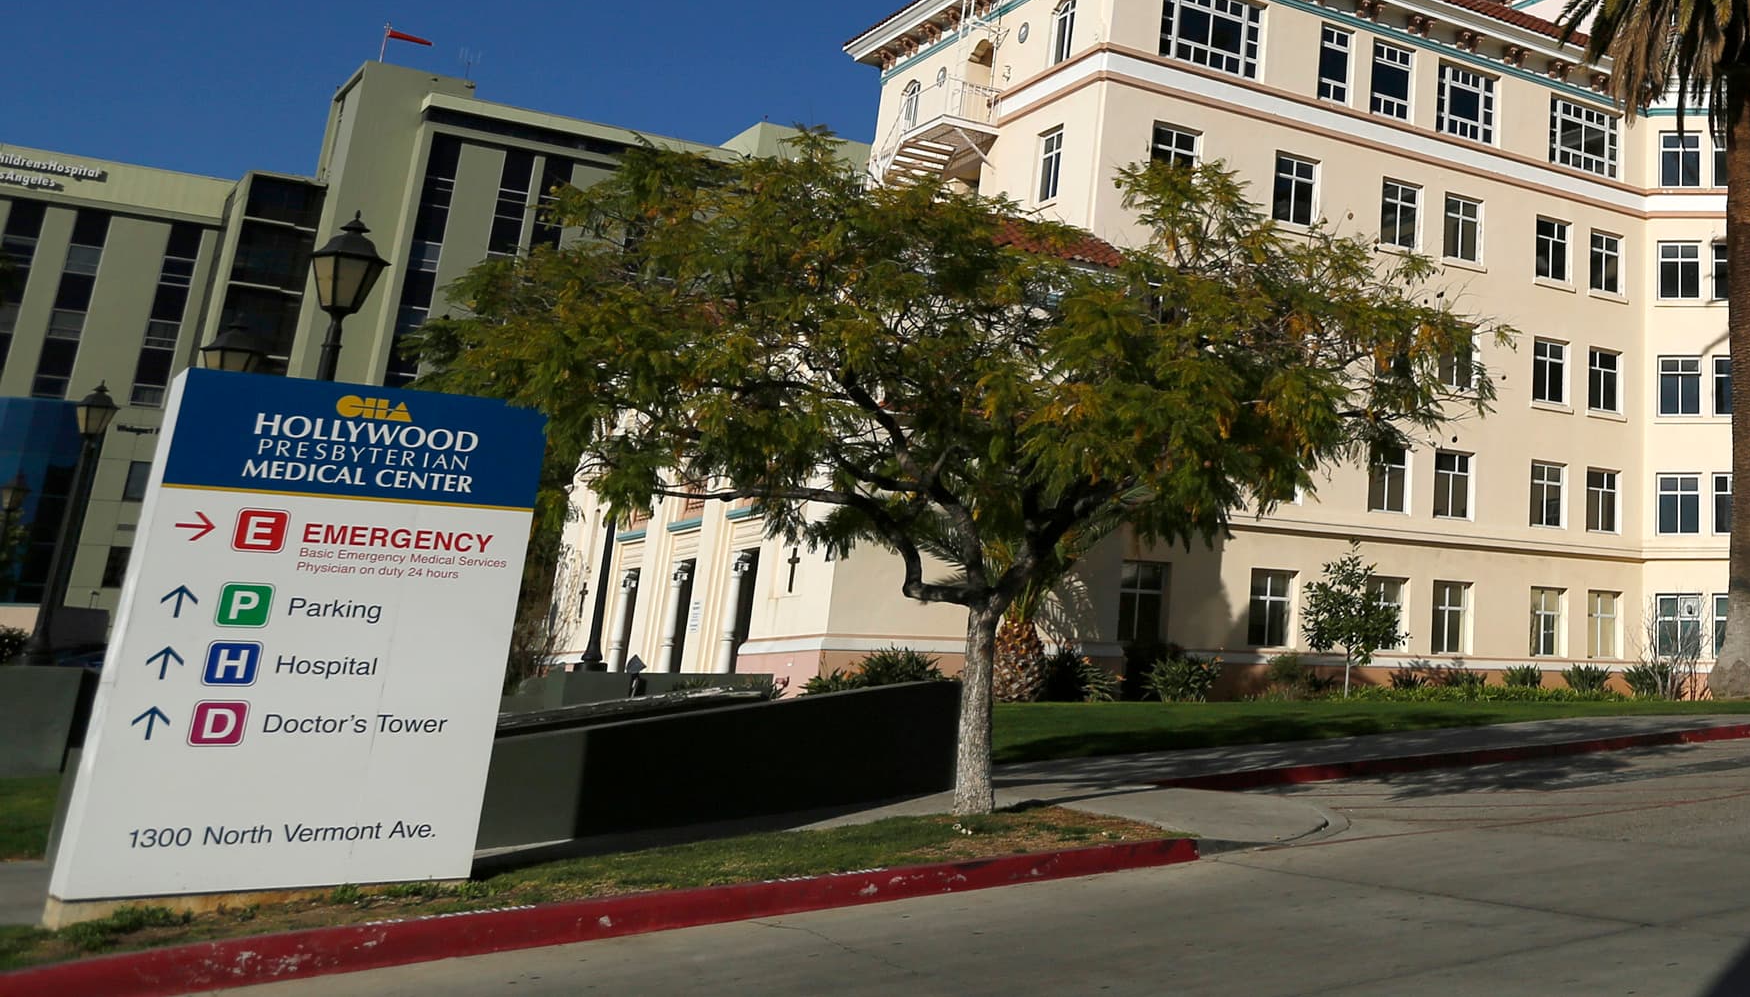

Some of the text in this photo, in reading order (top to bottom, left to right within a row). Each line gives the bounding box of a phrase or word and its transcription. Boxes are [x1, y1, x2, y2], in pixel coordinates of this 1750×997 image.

[254, 413, 479, 452] HOLLYWOOD
[257, 439, 469, 471] PRESBYTERIAN
[241, 459, 473, 493] MEDICAL CENTER
[244, 516, 494, 553] E EMERGENCY
[297, 562, 459, 579] Physician on duty 24 hours
[299, 548, 508, 569] Basic Emergency Medical Services
[228, 590, 383, 624] P Parking
[214, 649, 378, 680] H Hospital
[201, 708, 448, 739] D Doctor's Tower
[129, 820, 437, 848] 1300 North Vermont Ave.
